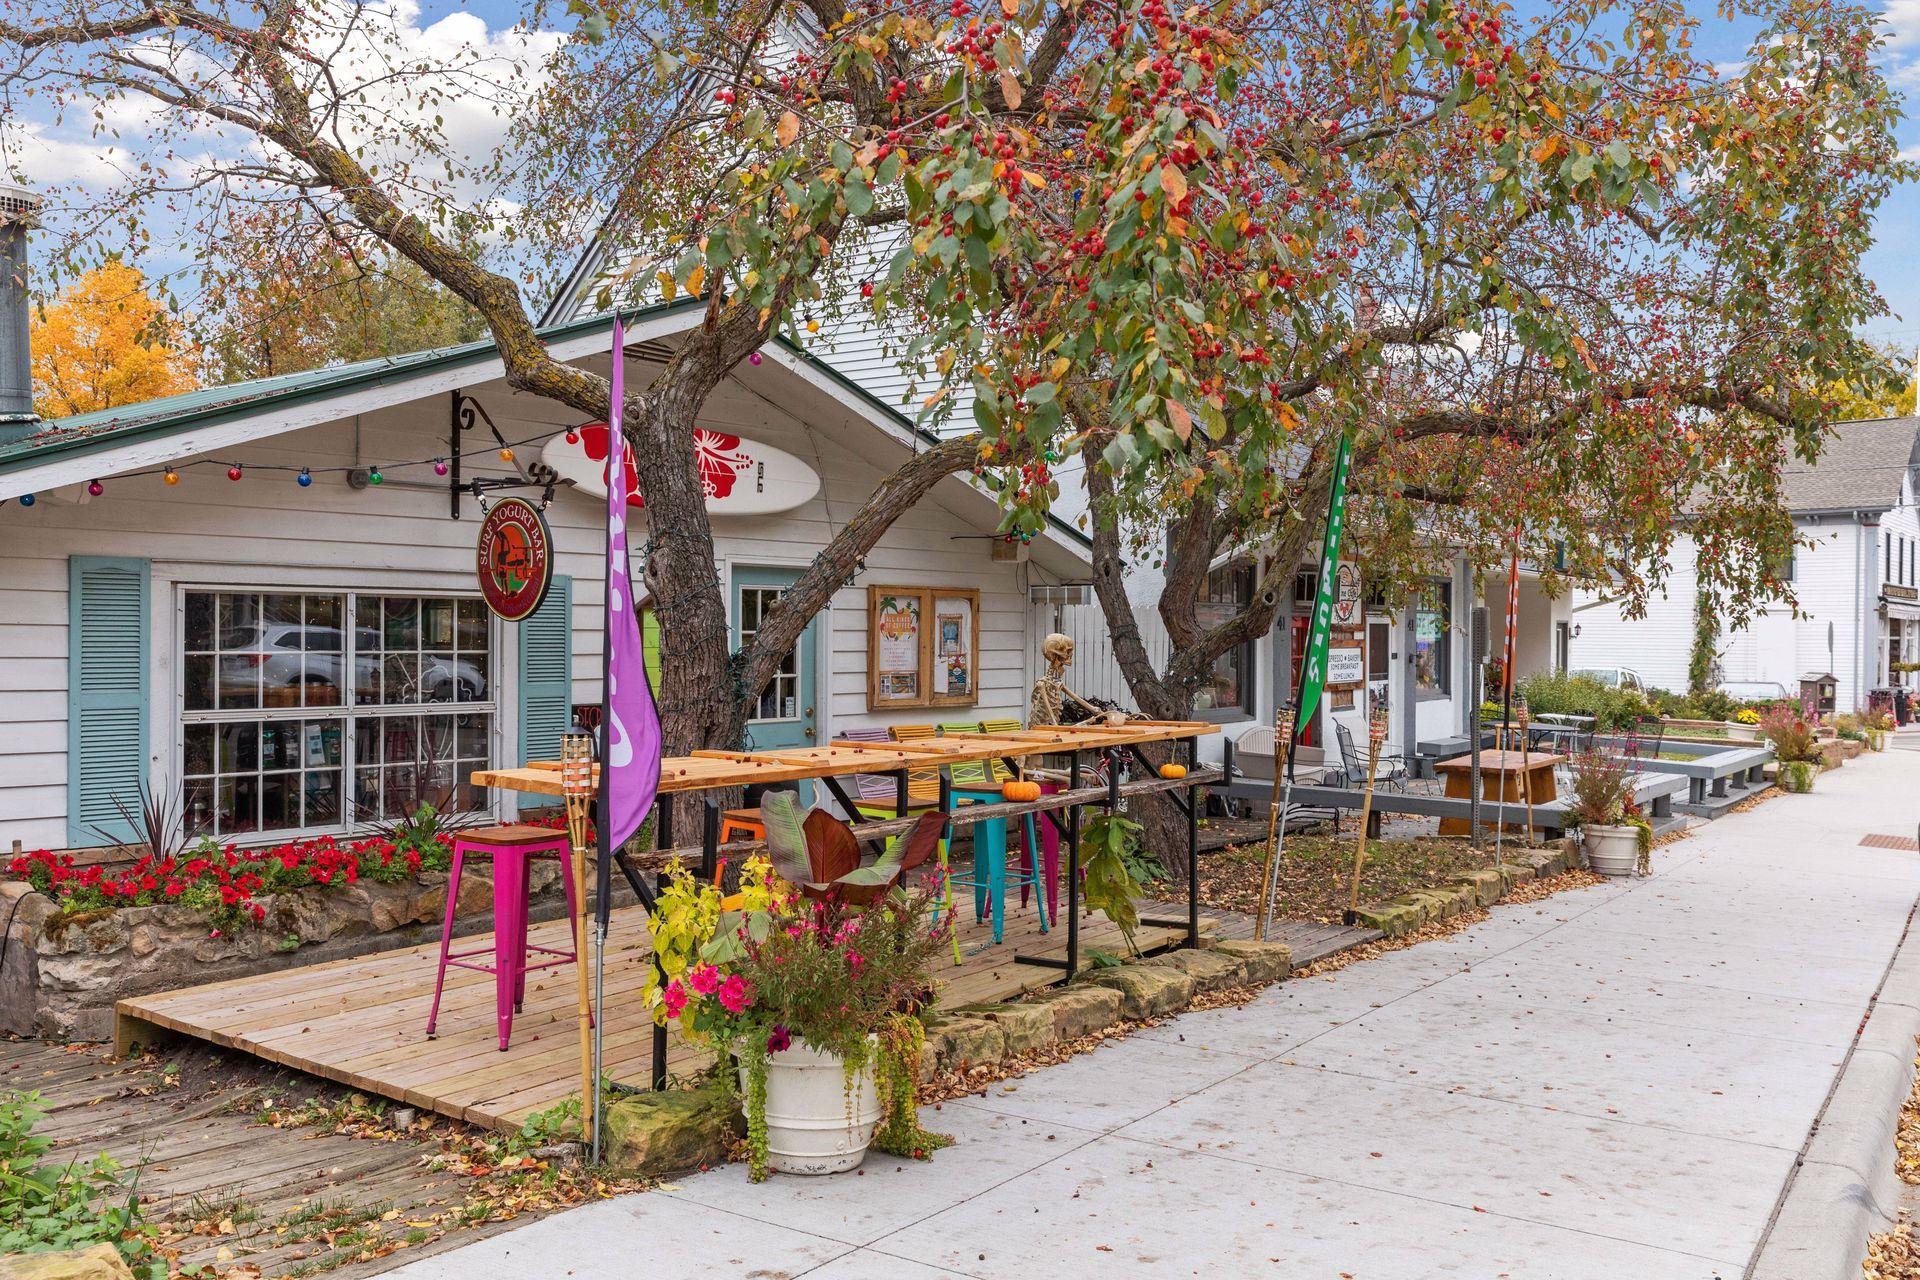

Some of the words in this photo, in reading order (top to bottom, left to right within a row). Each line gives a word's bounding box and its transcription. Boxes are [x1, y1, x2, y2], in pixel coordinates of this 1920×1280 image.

[480, 523, 493, 565] SURF
[493, 504, 535, 528] YOGURT
[531, 527, 544, 561] BAR
